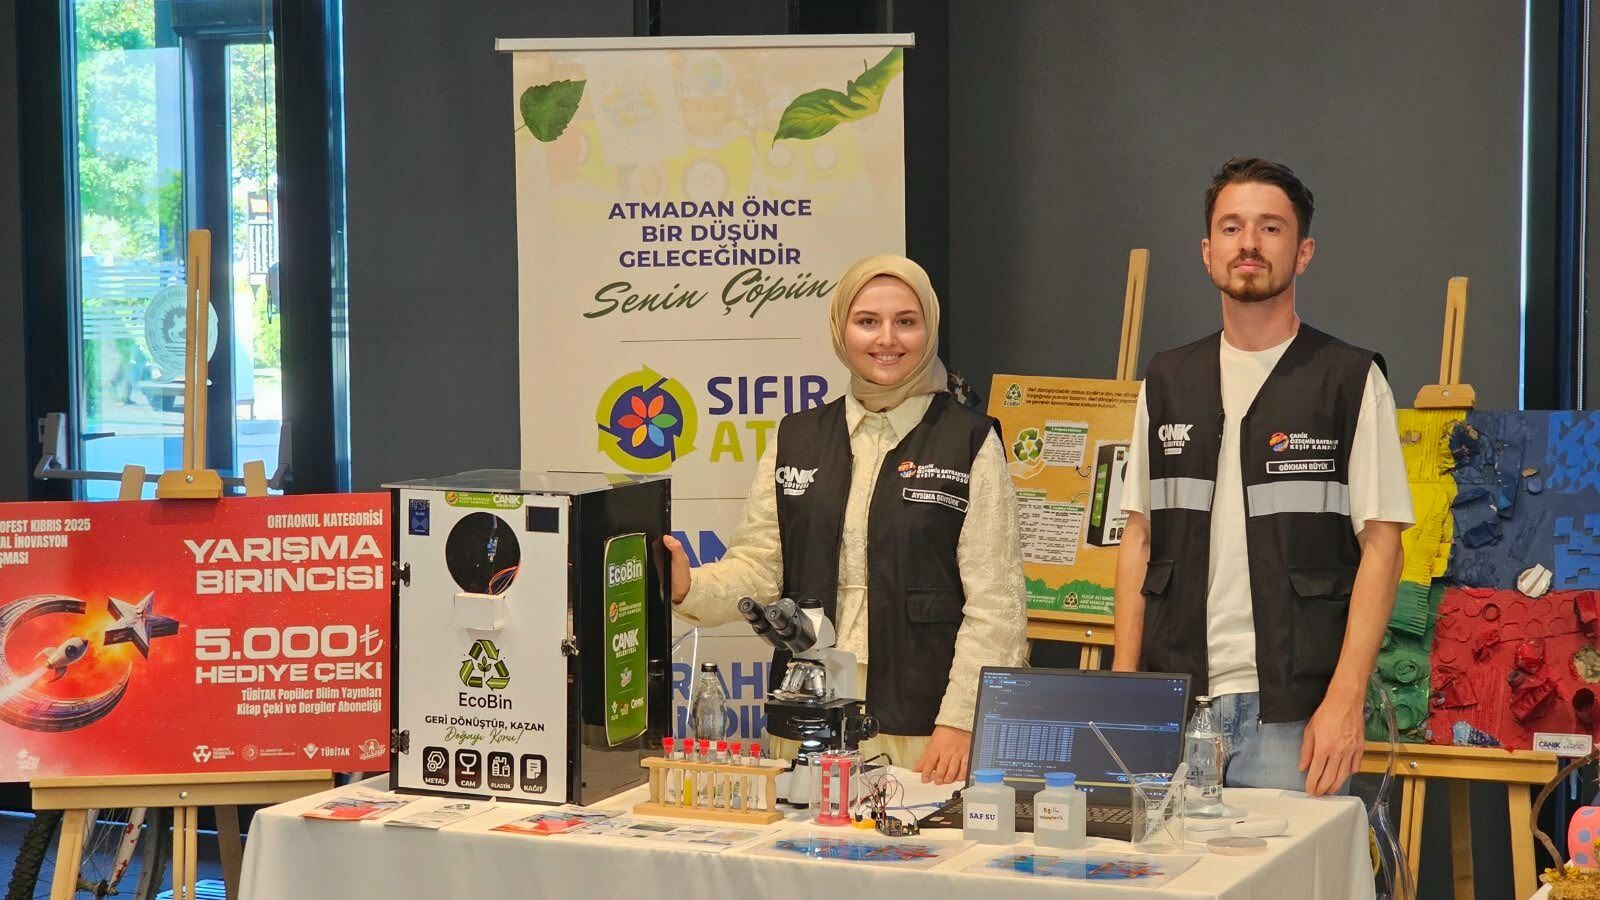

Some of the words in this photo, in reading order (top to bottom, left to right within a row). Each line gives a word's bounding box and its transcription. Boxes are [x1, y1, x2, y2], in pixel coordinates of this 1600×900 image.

[608, 200, 734, 219] ATMADAN
[742, 195, 812, 217] ÖNCE
[691, 219, 778, 244] DÜŞÜN
[619, 242, 801, 267] GELECEĞİNDİR
[582, 281, 709, 319] Senin
[721, 267, 838, 319] Çöpün
[707, 375, 828, 416] SIFIR
[709, 420, 776, 462] AT
[1278, 463, 1308, 471] GÖKHAN
[30, 519, 62, 532] KIBRIS
[64, 518, 91, 531] 2025
[268, 513, 321, 529] ORTAOKUL
[324, 509, 383, 527] KATEGORİSİ
[14, 533, 68, 549] İNOVASYON
[183, 534, 383, 564] YARIŞMA
[608, 556, 643, 588] EcoBin
[241, 687, 277, 701] TÜBİTAK
[278, 687, 314, 702] Popüler
[316, 686, 340, 699] Bilim
[341, 686, 382, 700] Yayınları
[458, 692, 513, 710] EcoBin
[237, 702, 261, 716] Kitap
[263, 702, 283, 718] Çeki
[285, 704, 296, 714] ve
[298, 701, 336, 715] Dergiler
[338, 699, 382, 714] Aboneliği
[425, 714, 448, 725] GERİ
[450, 715, 508, 731] DÖNÜŞTÜR,
[510, 721, 545, 731] KAZAN
[321, 746, 350, 757] TÜBİTAK
[425, 777, 447, 785] METAL
[523, 784, 543, 793] KAĞIT
[985, 813, 996, 821] SU
